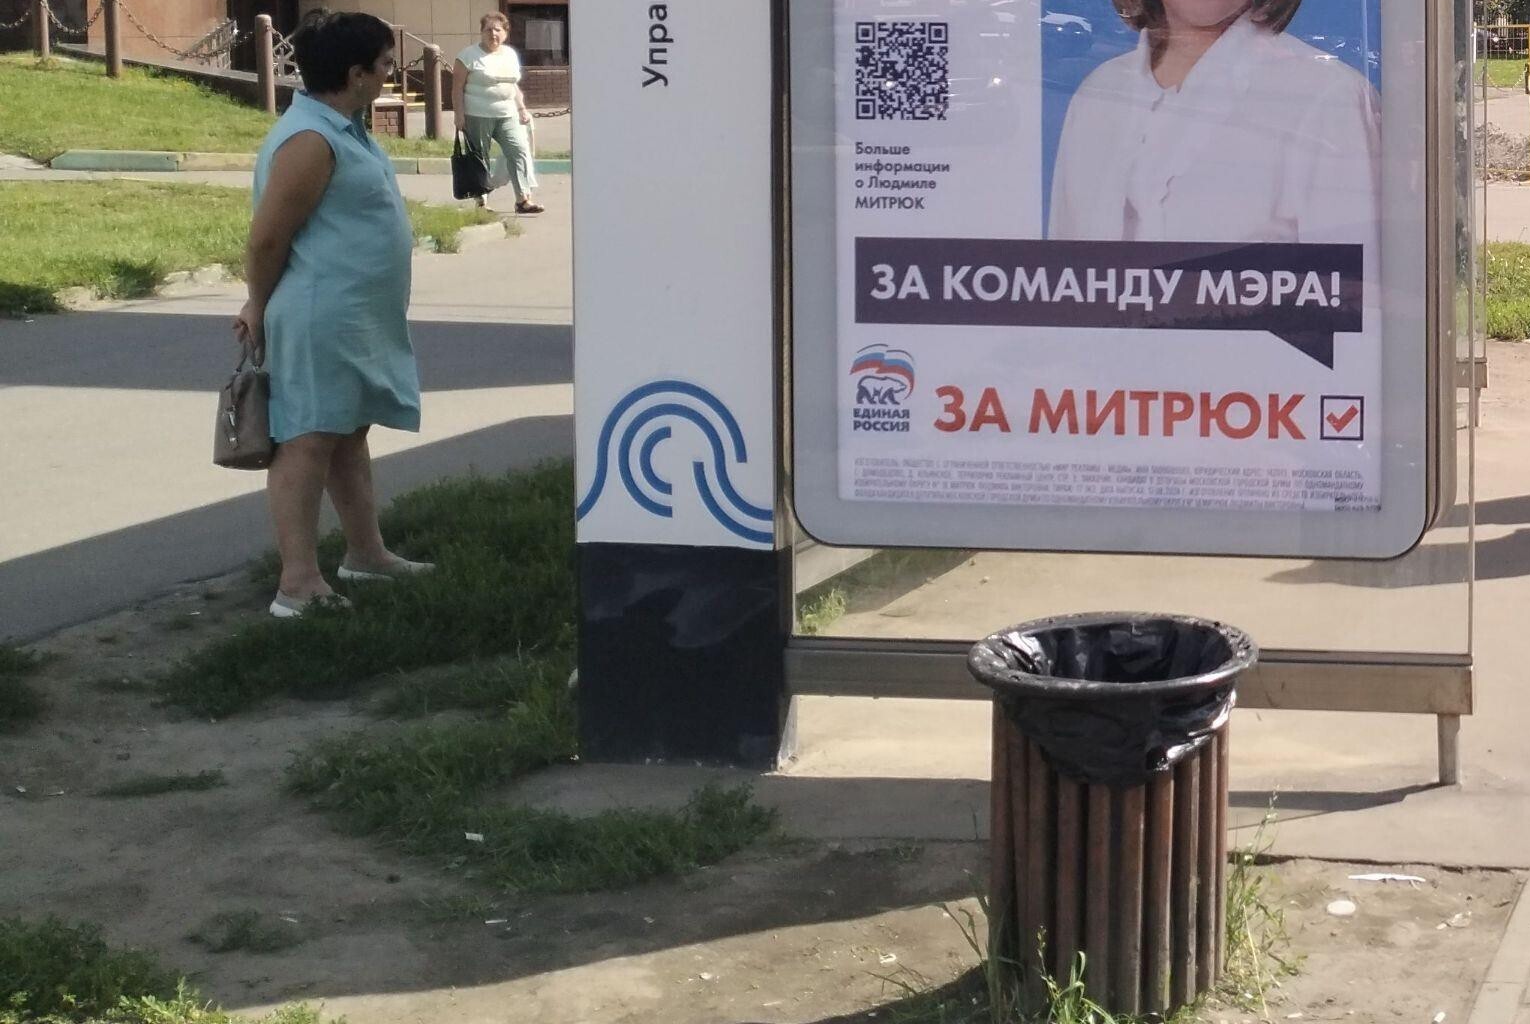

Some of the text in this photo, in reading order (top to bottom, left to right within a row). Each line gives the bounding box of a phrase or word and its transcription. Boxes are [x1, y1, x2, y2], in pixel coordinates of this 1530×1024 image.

[855, 141, 911, 156] Больше
[855, 158, 950, 176] информации
[854, 175, 937, 191] о Людмиле
[854, 196, 925, 210] МИТРЮК
[870, 263, 1341, 312] ЗА КОМАНДУ МЭРА!
[853, 408, 910, 420] ЕДИНАЯ
[933, 385, 1307, 440] ЗА МИТРЮК
[853, 420, 910, 432] РОССИЯ
